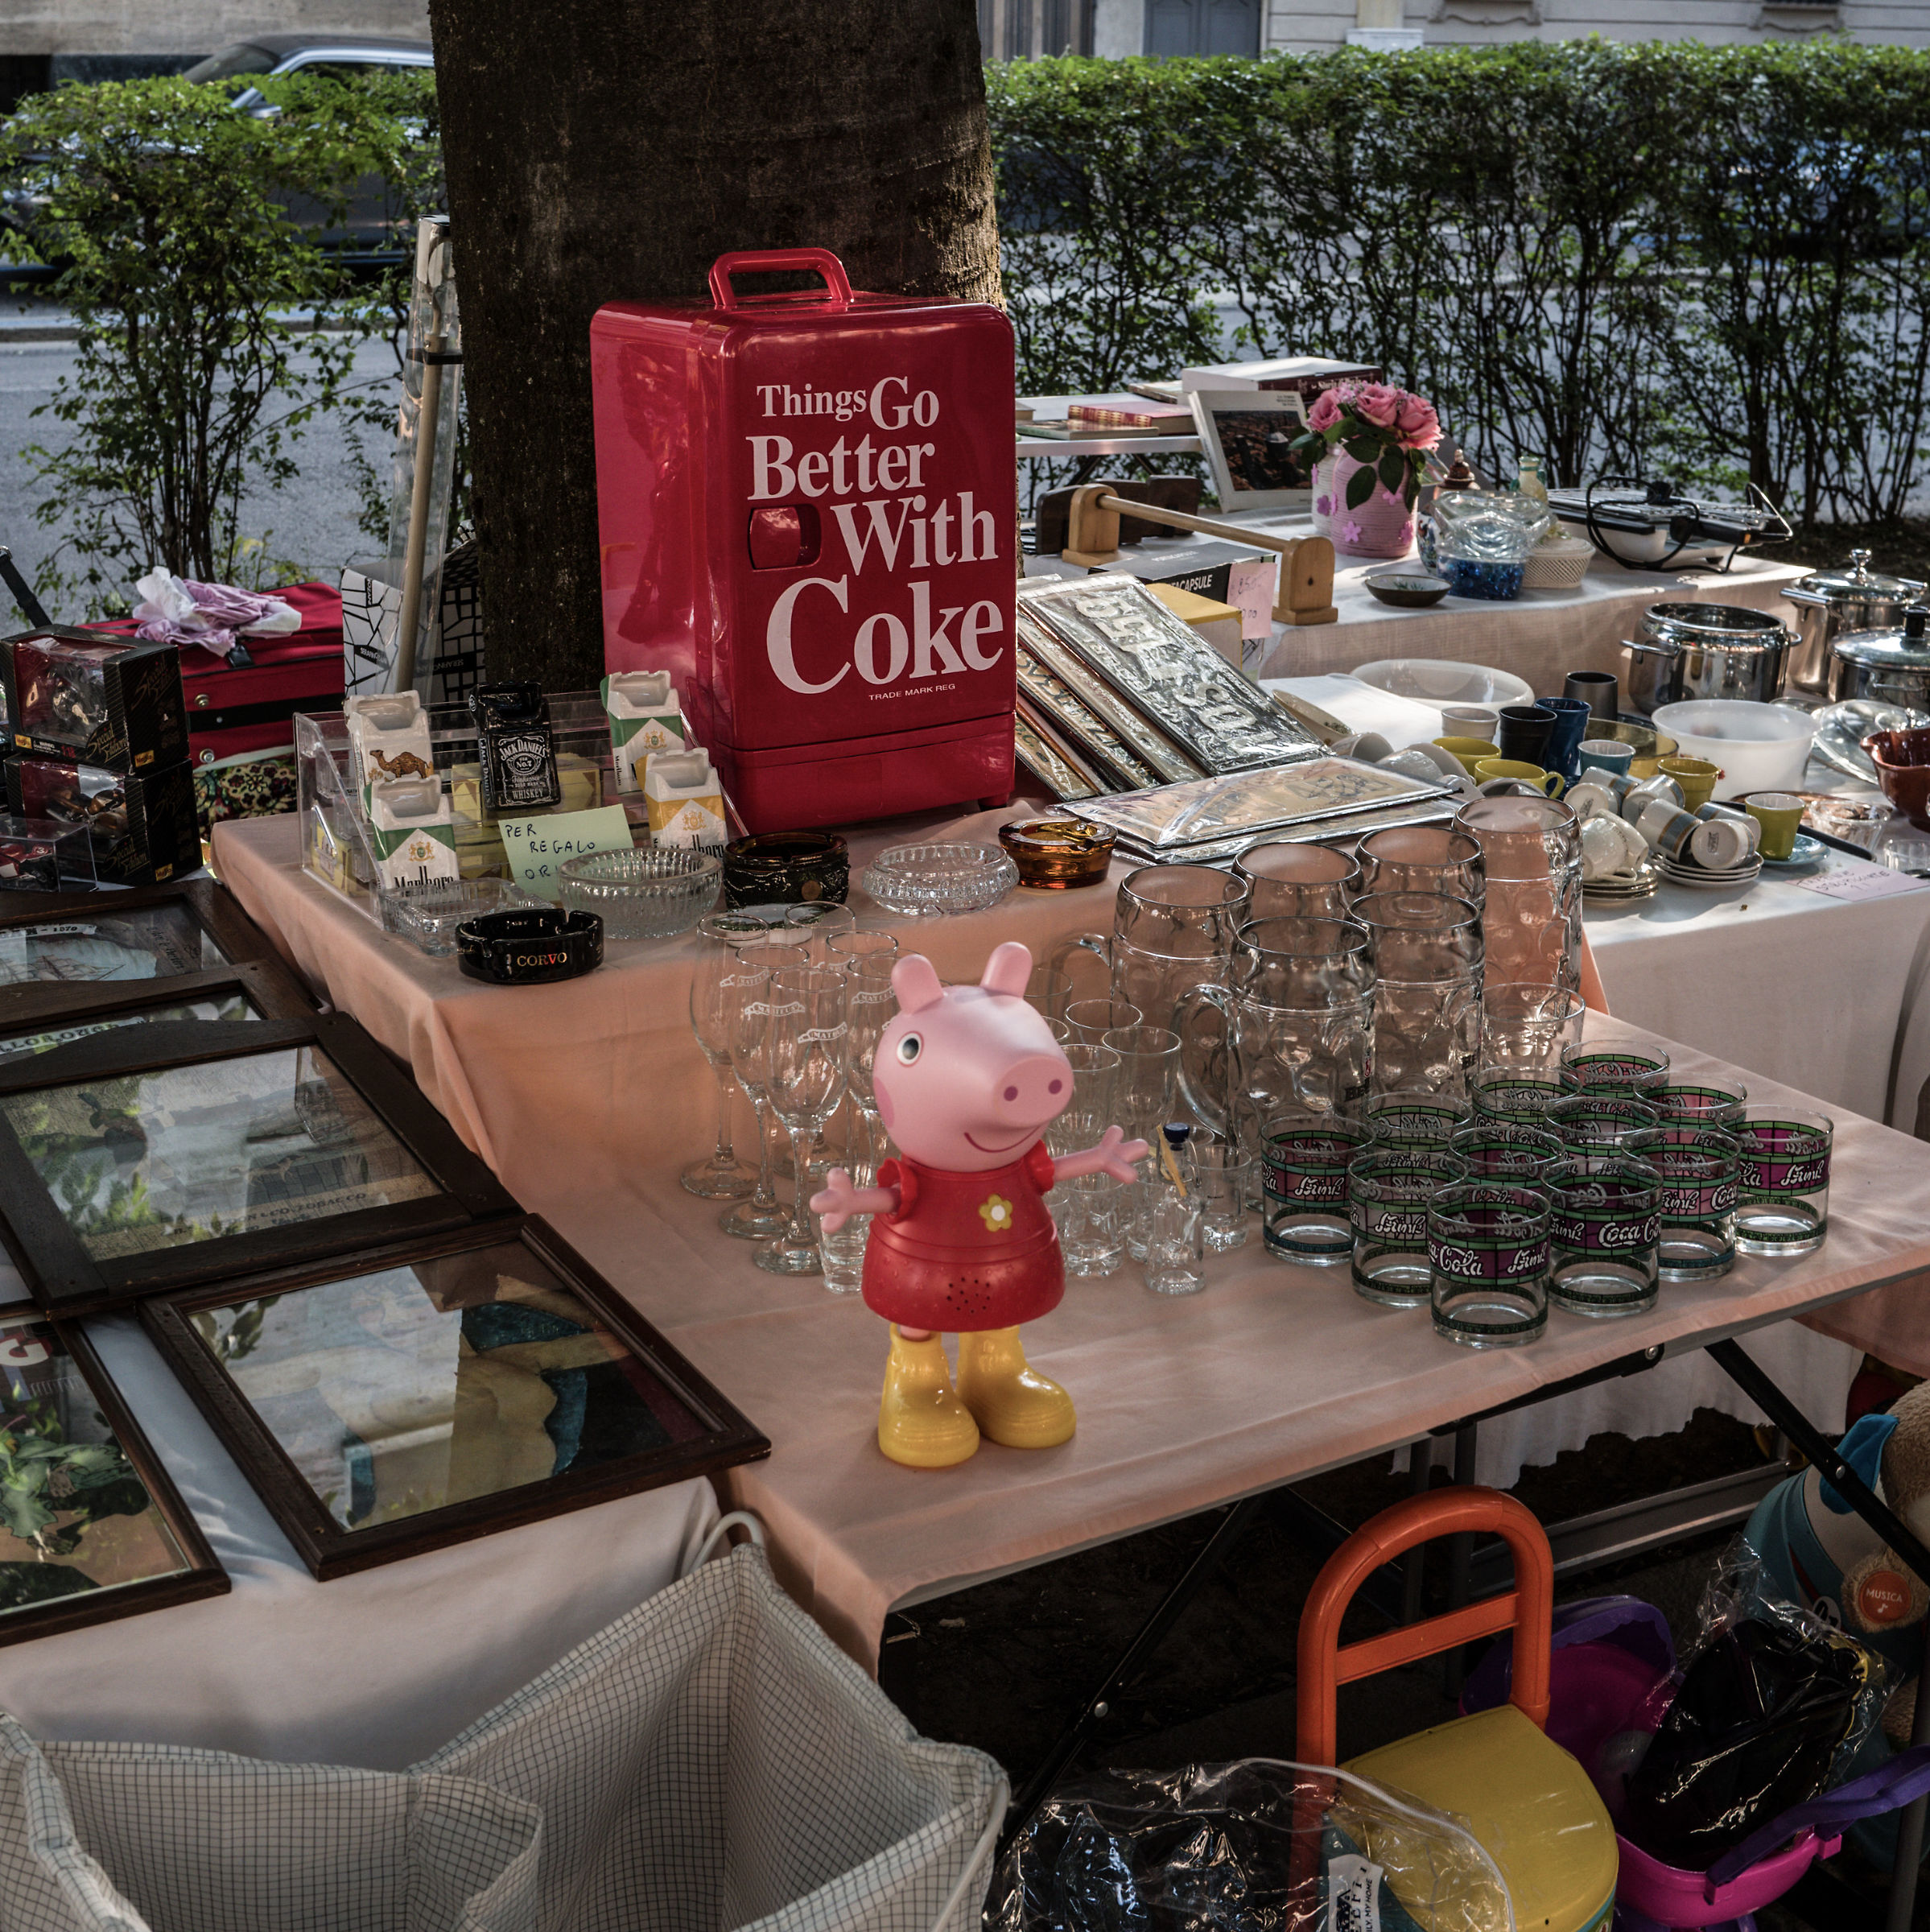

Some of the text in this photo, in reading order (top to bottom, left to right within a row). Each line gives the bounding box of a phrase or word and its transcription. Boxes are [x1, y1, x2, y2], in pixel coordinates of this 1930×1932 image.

[757, 377, 939, 430] Things Go
[745, 434, 935, 501] Better
[830, 492, 998, 576] With
[766, 574, 1004, 694] Coke
[868, 683, 956, 700] TRADE MARK REG
[499, 739, 548, 761] JACK DANIEL'S
[512, 788, 543, 799] WHISKEY
[505, 824, 537, 838] PER
[530, 840, 596, 854] REGALO
[670, 834, 725, 858] lboro
[394, 865, 454, 890] Marlboro
[516, 952, 567, 967] CORVO
[1866, 1587, 1903, 1603] MUSICA
